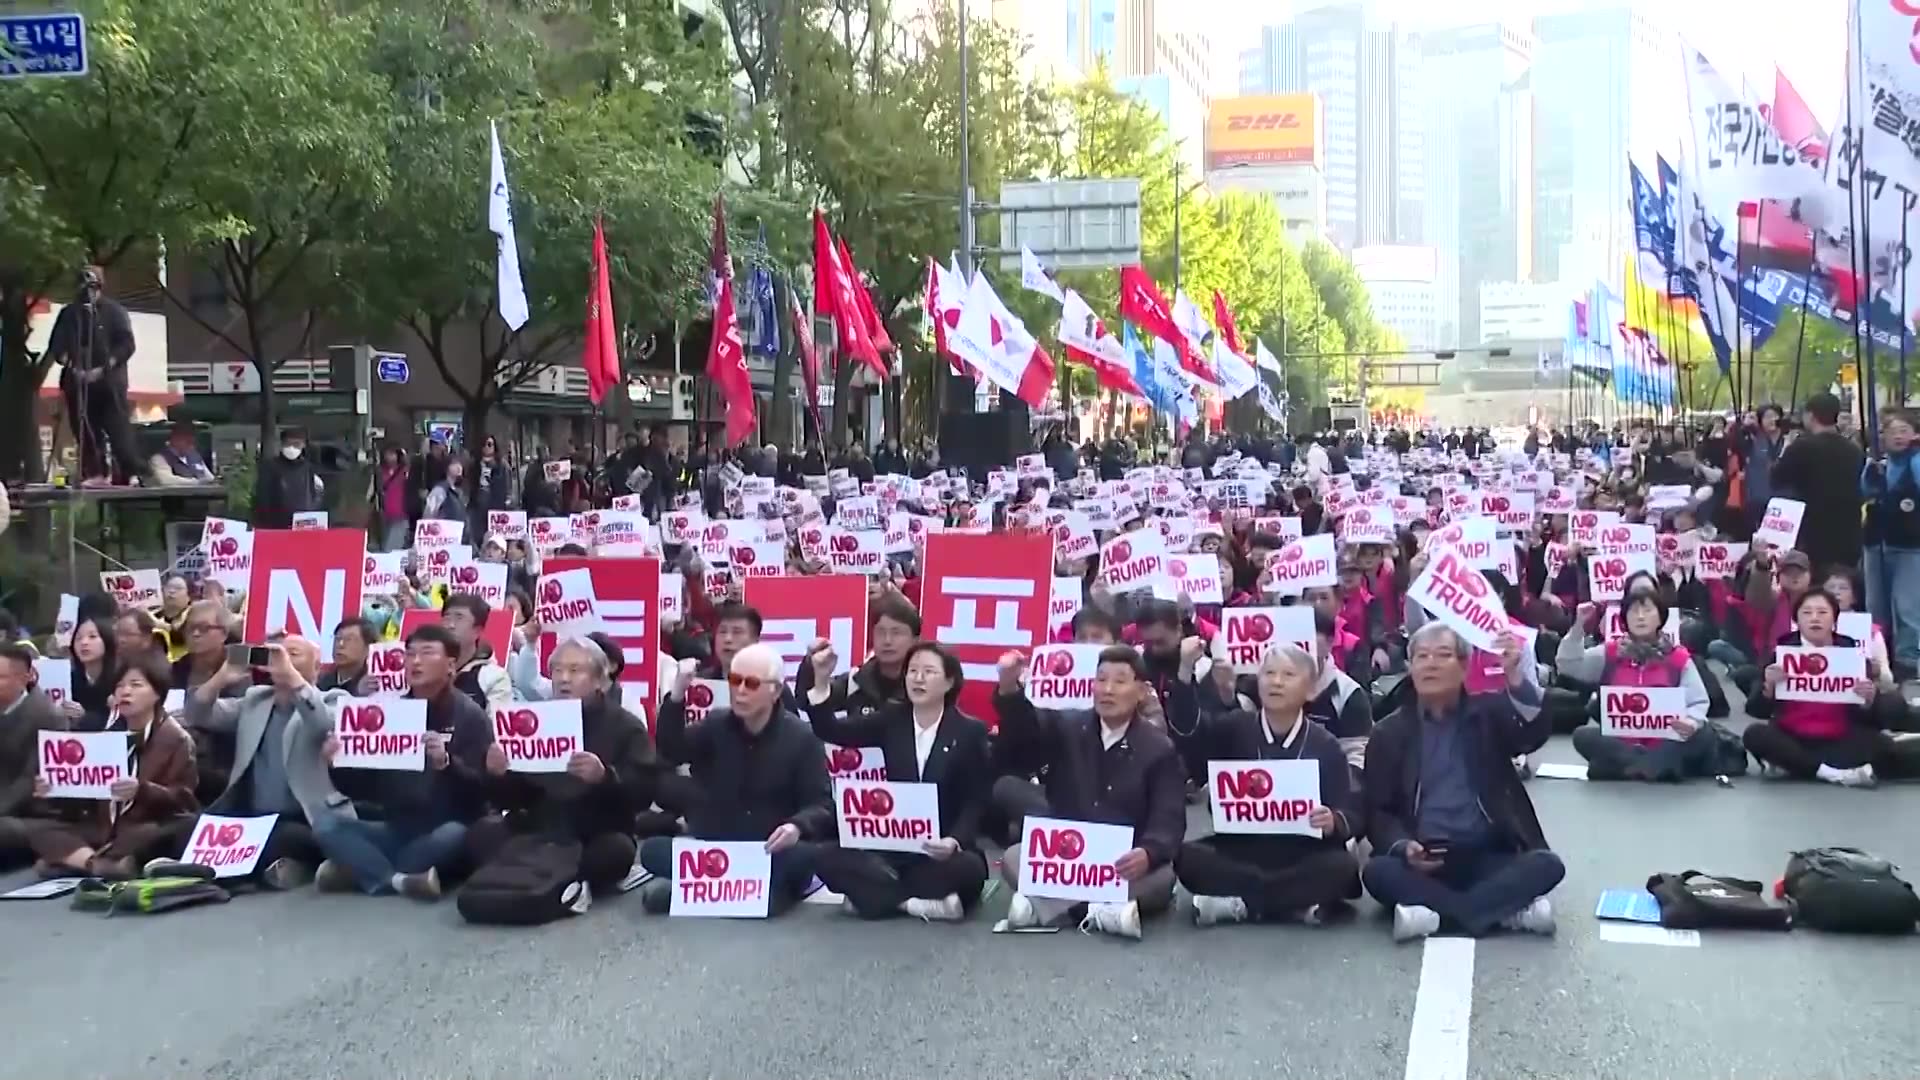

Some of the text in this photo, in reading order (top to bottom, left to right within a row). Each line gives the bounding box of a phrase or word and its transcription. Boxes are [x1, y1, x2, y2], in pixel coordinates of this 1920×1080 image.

[1227, 113, 1300, 130] DHL
[1482, 497, 1510, 512] NO
[490, 513, 509, 524] NO
[532, 521, 551, 534] NO
[1572, 514, 1598, 528] NO
[418, 522, 442, 536] NO
[702, 523, 729, 541] NO
[801, 528, 821, 545] NO
[1572, 529, 1597, 540] TRU
[1602, 527, 1631, 543] NO
[211, 537, 238, 557] NO
[702, 542, 725, 554] TRU
[830, 535, 859, 552] NO
[1701, 546, 1727, 560] NO
[211, 555, 249, 570] TRUM
[428, 550, 450, 566] NO
[729, 547, 756, 566] NO
[831, 552, 881, 567] TRUMP!
[1102, 540, 1132, 570] NO
[428, 567, 447, 578] TRU
[451, 566, 479, 584] NO
[1436, 555, 1487, 598] NO
[1594, 559, 1627, 578] NO
[1701, 561, 1736, 574] TRUM
[106, 575, 135, 590] NO
[706, 572, 728, 587] NO
[1594, 578, 1624, 593] TRU
[708, 588, 728, 598] TRU
[537, 599, 594, 624] TRUMP!
[1426, 575, 1504, 633] TRUMP
[1228, 614, 1274, 643] NO
[372, 648, 405, 673] NO
[1033, 650, 1074, 677] NO
[1783, 653, 1828, 675] NO
[1607, 693, 1650, 714] NO
[341, 705, 385, 733] NO
[495, 709, 539, 738] NO
[44, 739, 85, 766] NO
[340, 735, 417, 757] TRUMP!
[499, 737, 576, 760] TRUMP!
[45, 764, 121, 787] TRUMP!
[1217, 769, 1273, 799] NO
[843, 788, 894, 817] NO
[1220, 799, 1313, 823] TRUMP!
[196, 823, 245, 848] NO
[845, 816, 932, 841] TRUMP!
[1028, 827, 1086, 861] NO
[192, 844, 261, 868] TRUMP!
[680, 848, 729, 880] NO
[1028, 861, 1121, 888] TRUMP!
[680, 879, 763, 904] TRUMP!
